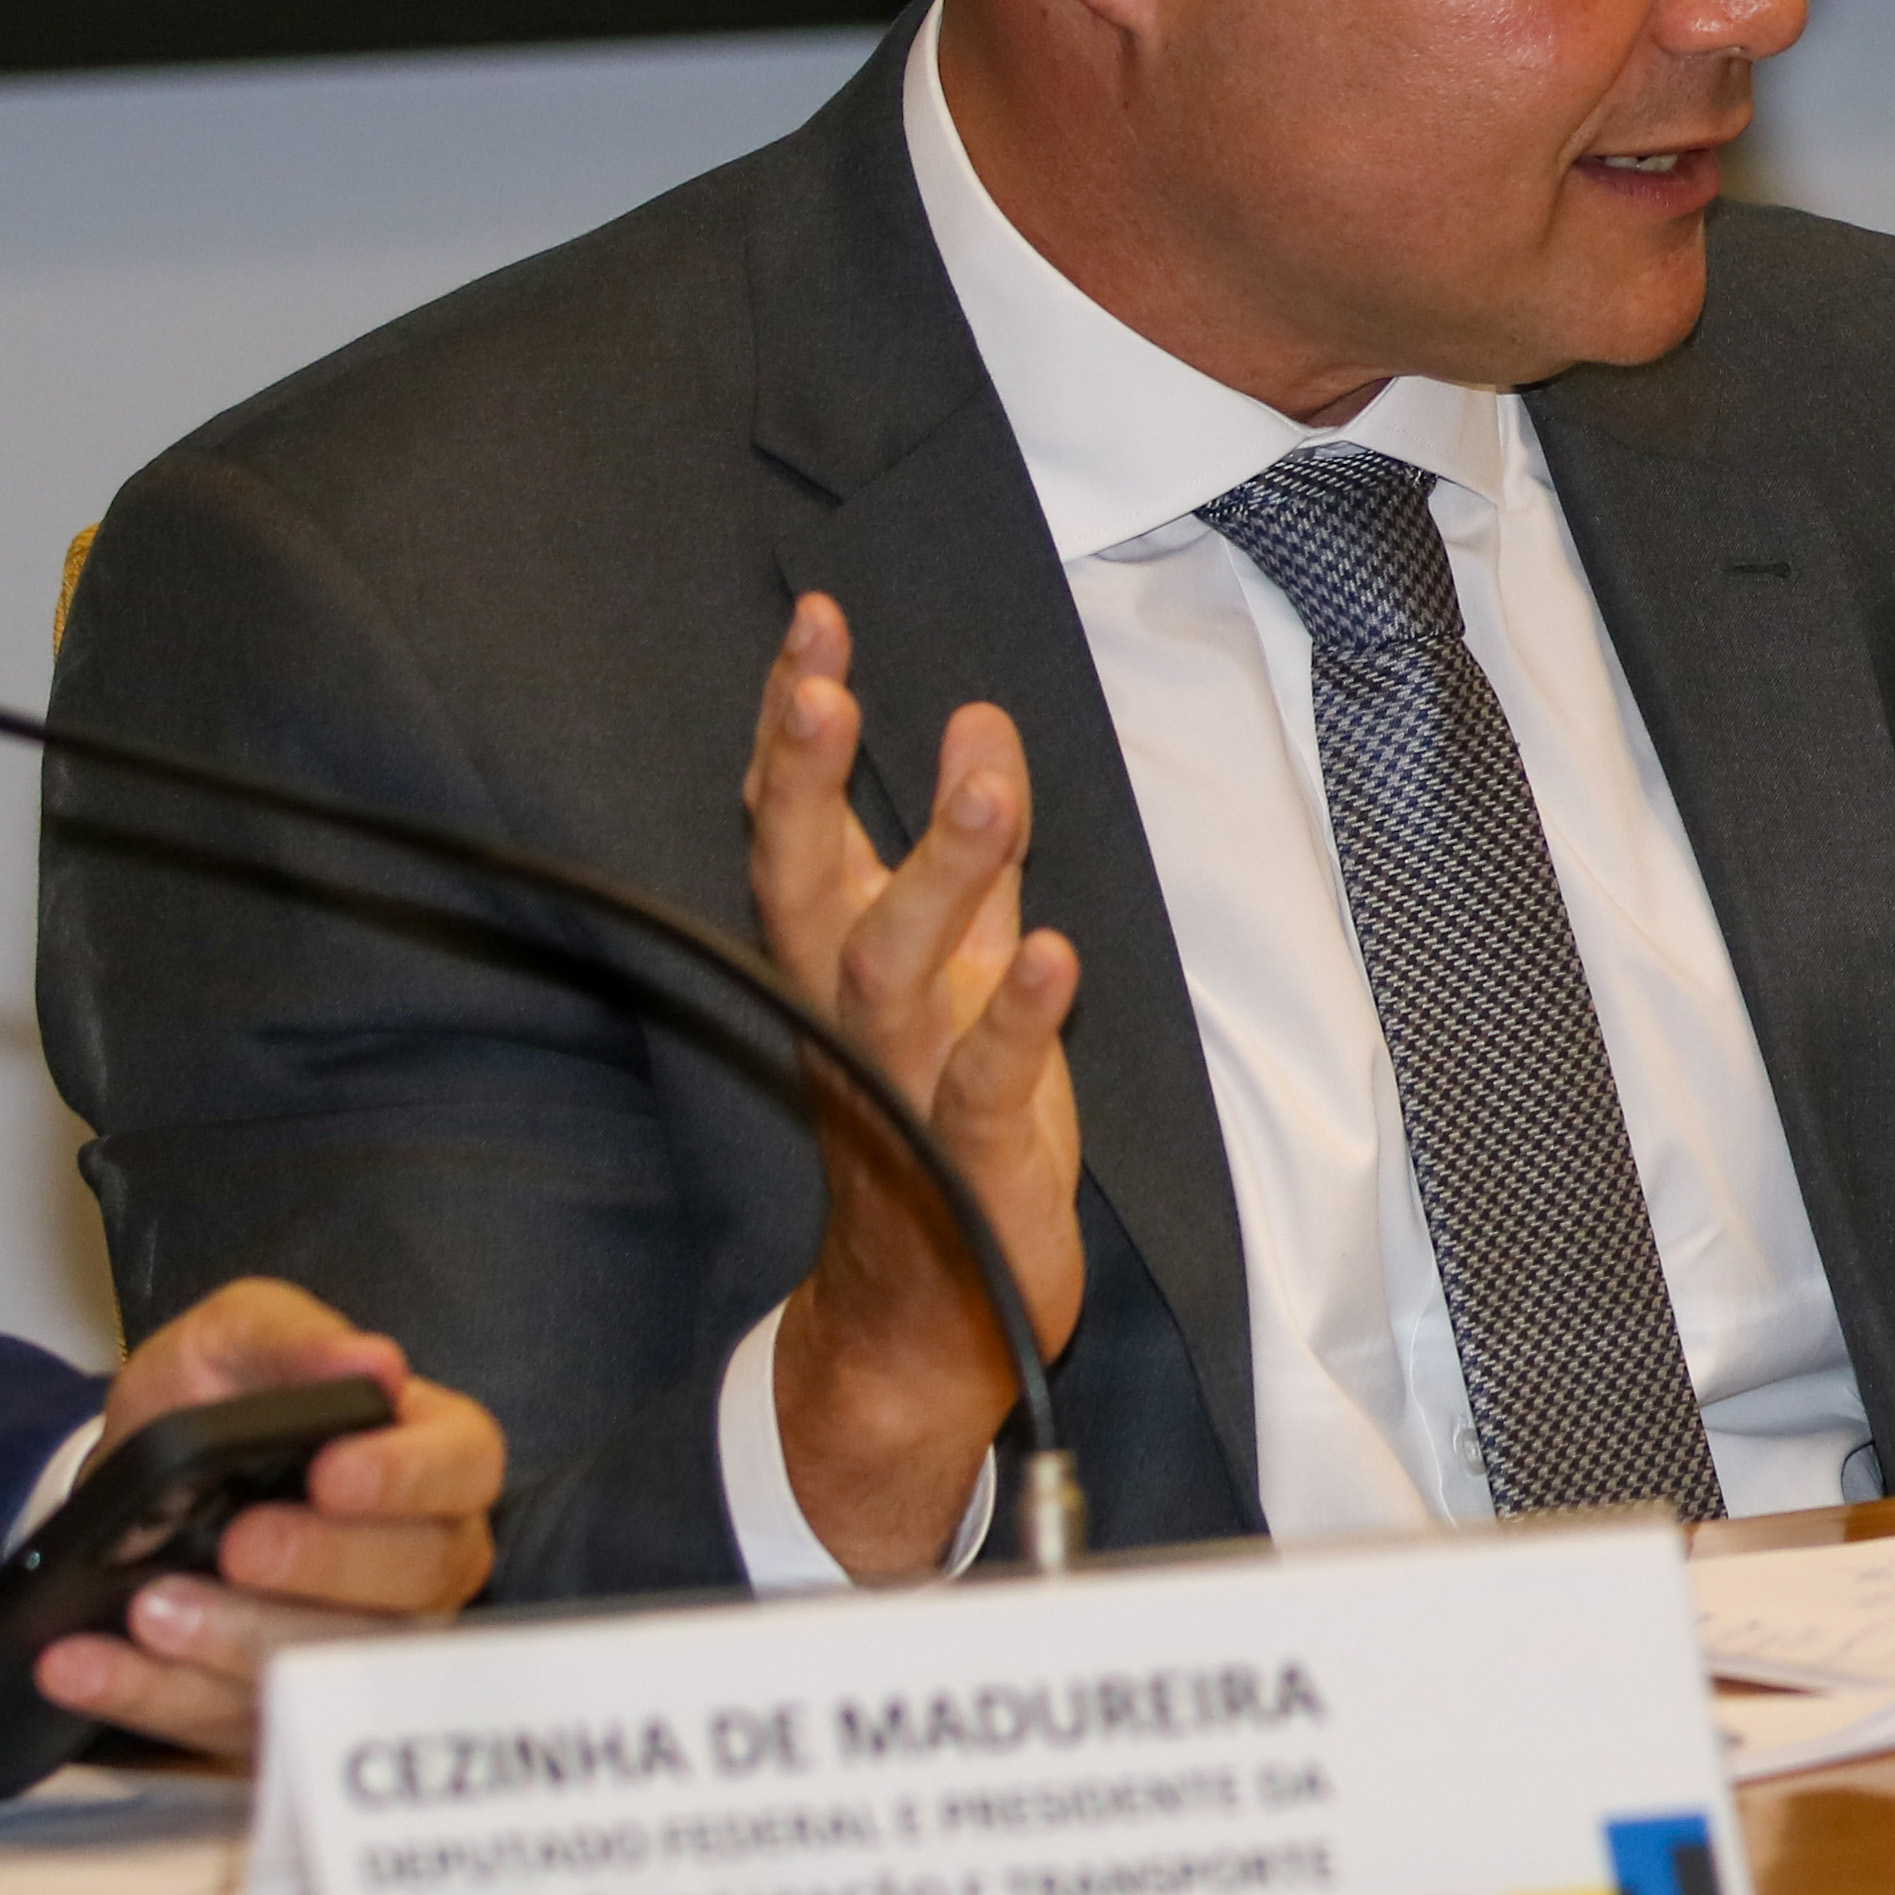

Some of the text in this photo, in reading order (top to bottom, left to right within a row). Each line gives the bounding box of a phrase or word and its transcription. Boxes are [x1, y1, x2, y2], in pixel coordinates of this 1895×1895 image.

[341, 1661, 1330, 1809] CEZINHA DE MADUREIRA
[361, 1759, 1335, 1888] DEPUTADO FEDERAL E PRESIDENTE DA
